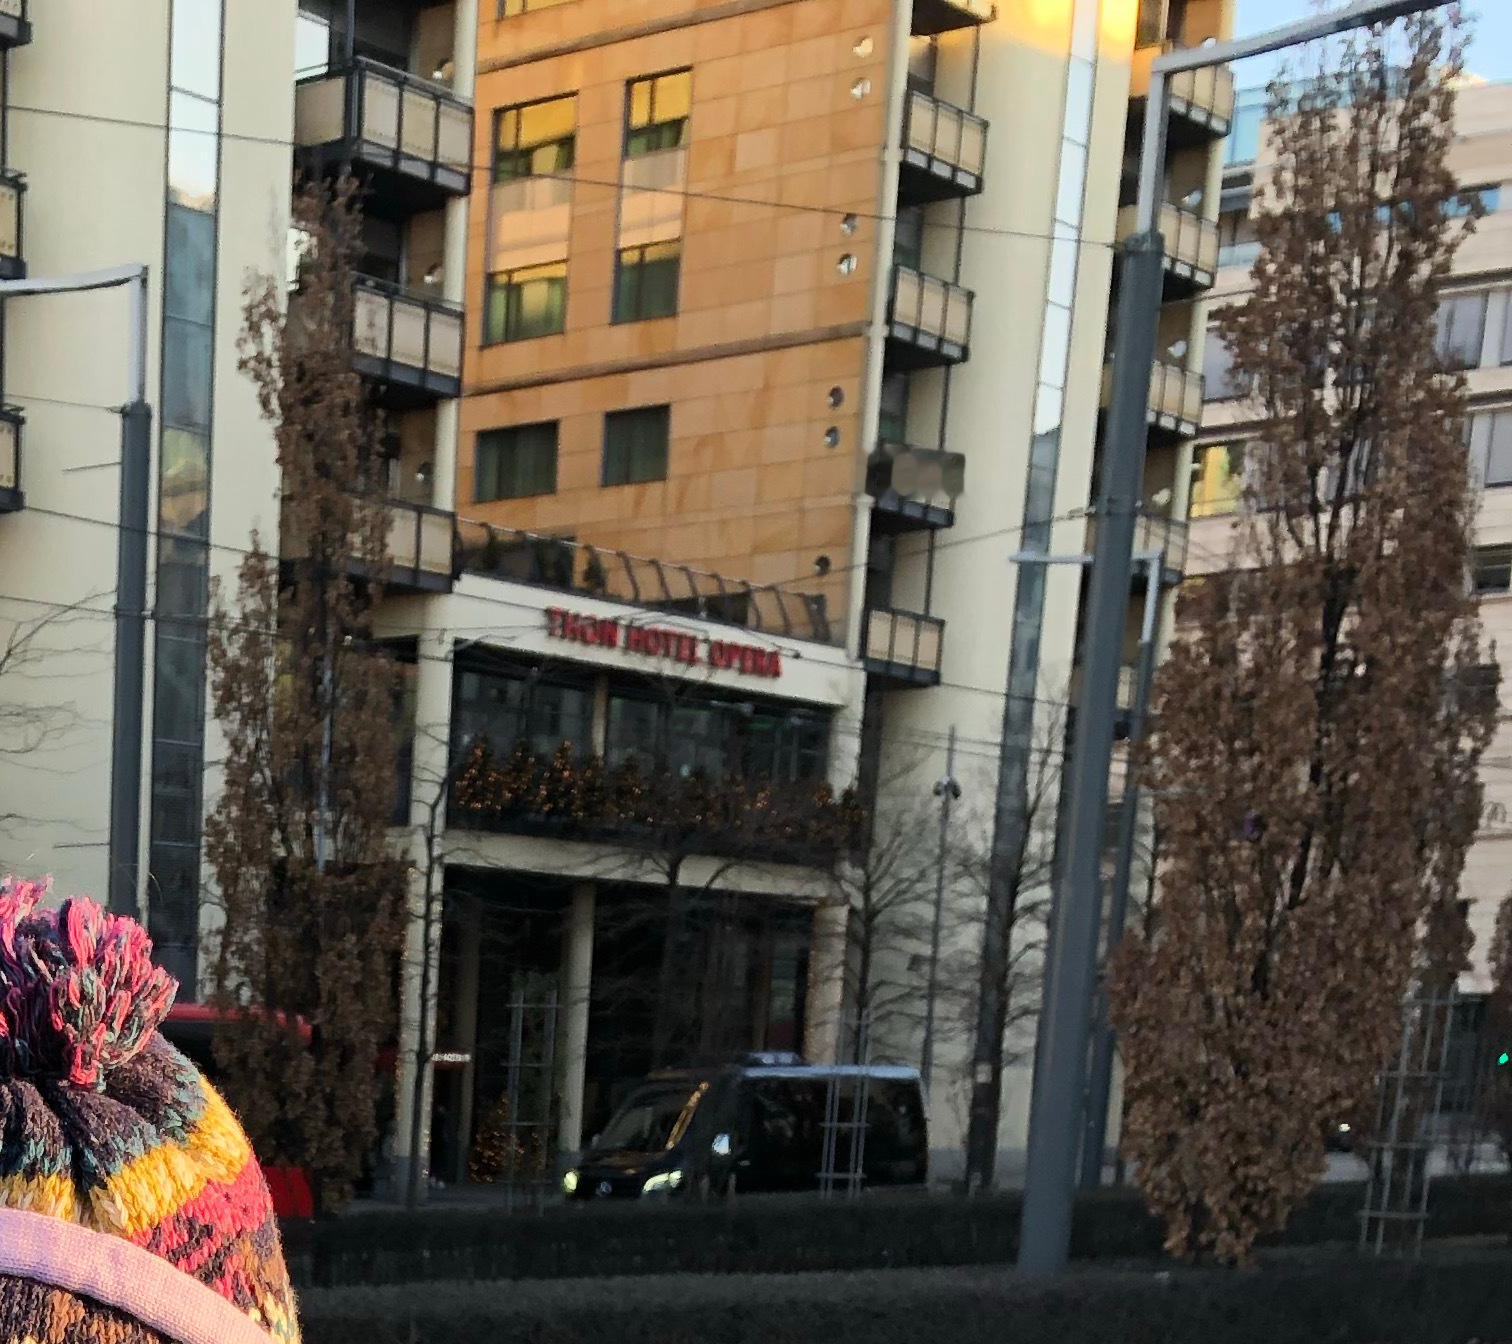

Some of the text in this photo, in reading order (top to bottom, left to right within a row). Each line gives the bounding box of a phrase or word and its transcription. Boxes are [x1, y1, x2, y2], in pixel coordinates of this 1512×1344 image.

[545, 605, 781, 677] THON HOTEL OPERA
